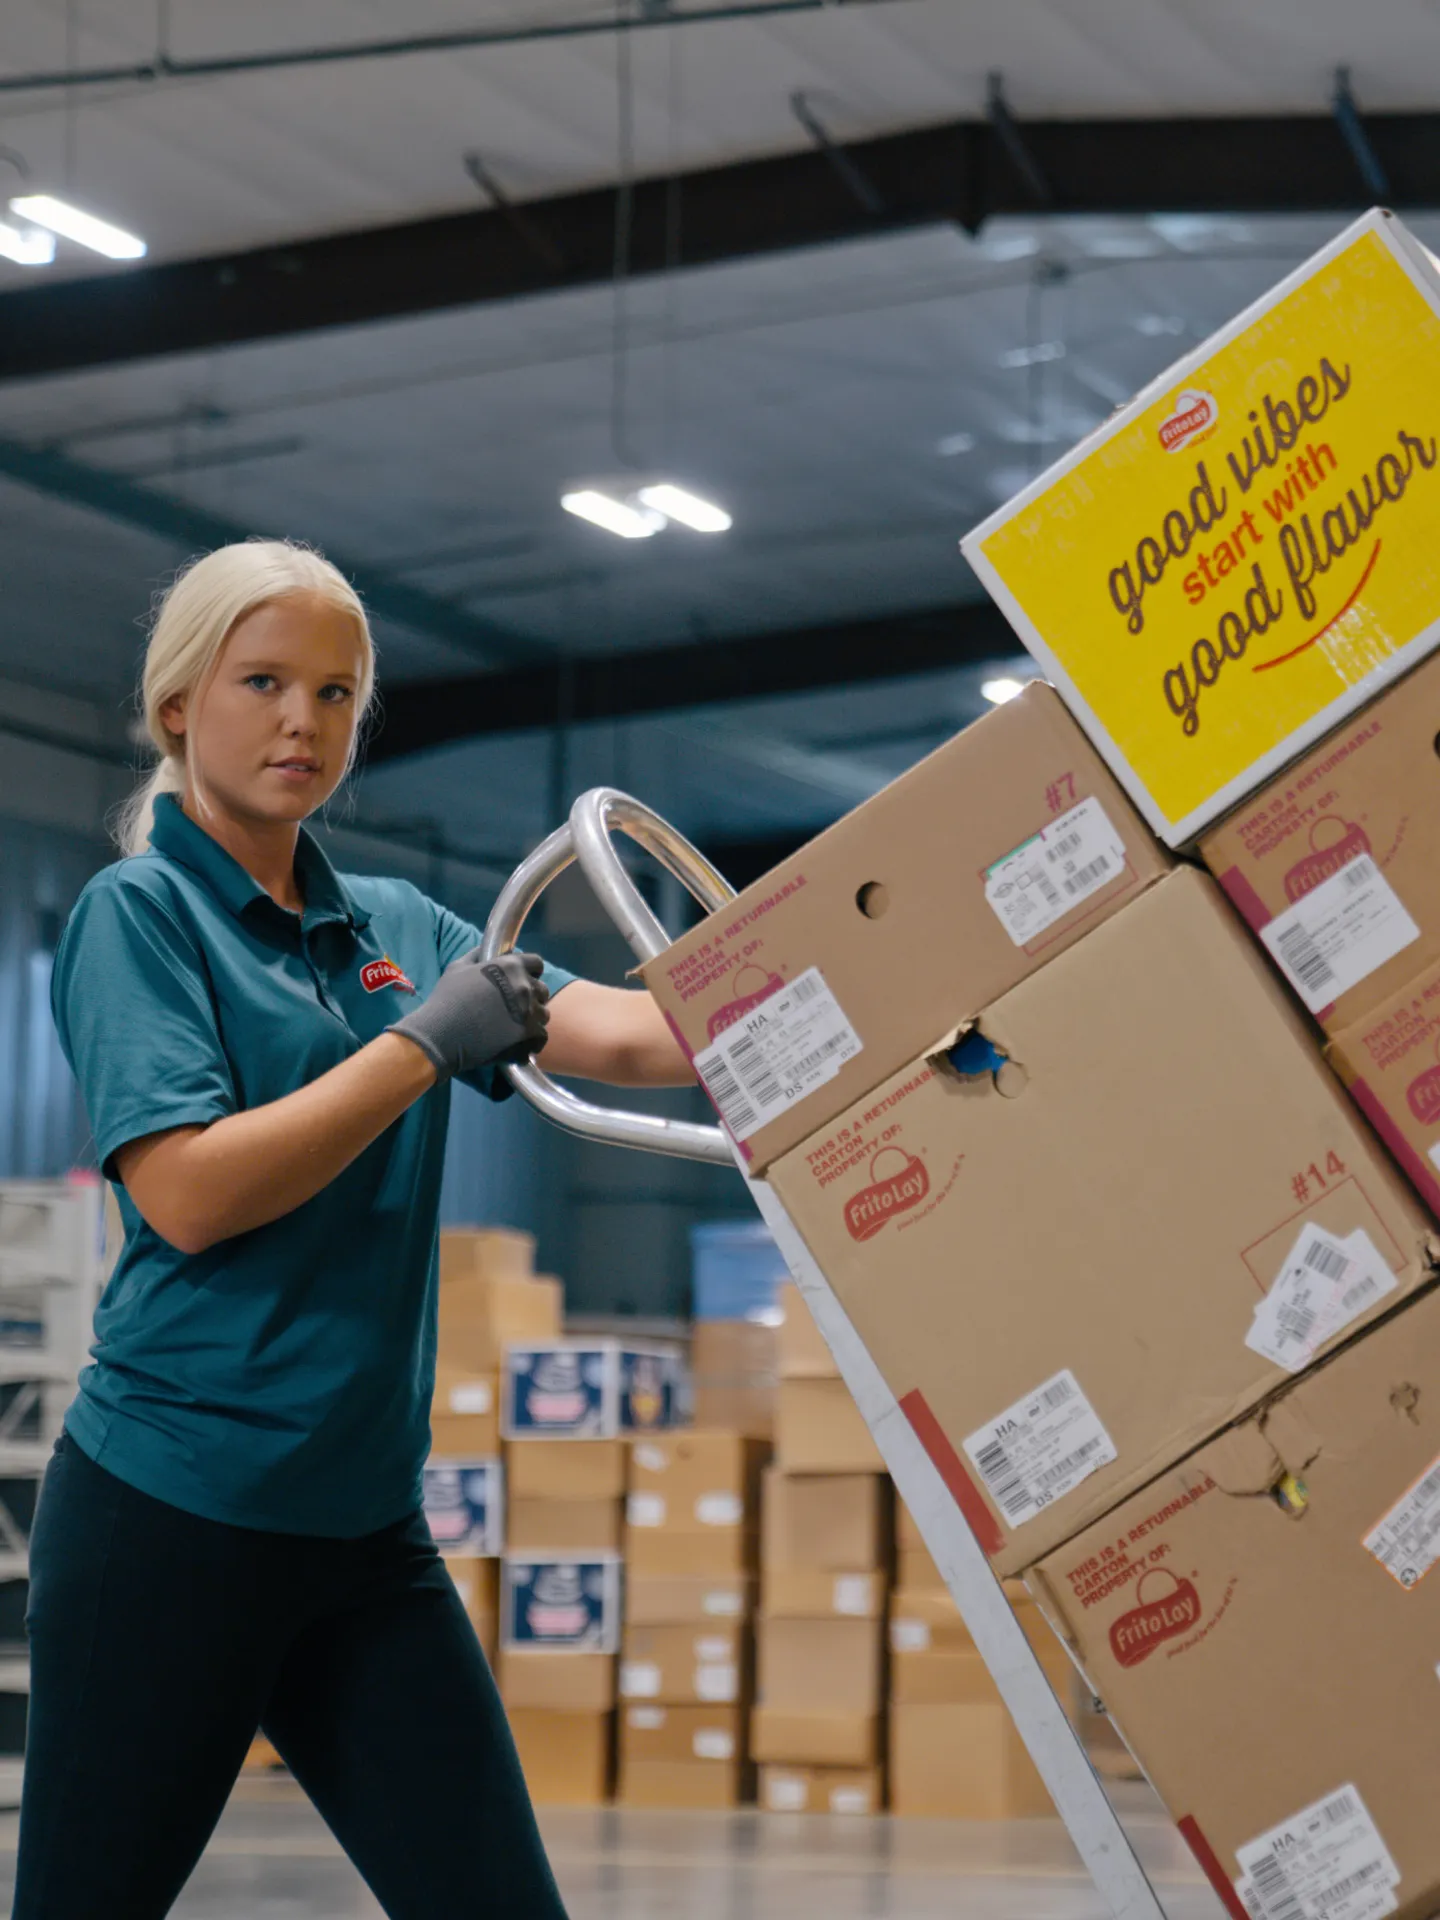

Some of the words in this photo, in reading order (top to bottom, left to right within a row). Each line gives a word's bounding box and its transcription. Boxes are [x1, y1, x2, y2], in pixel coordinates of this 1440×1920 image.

[1109, 461, 1227, 635] good
[1227, 357, 1350, 494] vibes
[1182, 510, 1264, 605] start
[1263, 443, 1338, 523] with
[1163, 562, 1283, 737] good
[1279, 430, 1436, 621] flavor
[1045, 771, 1076, 813] #7
[1236, 811, 1268, 838] THIS
[1296, 720, 1382, 792] RETURNABLE
[1245, 803, 1299, 850] CARTON
[1253, 804, 1316, 860] PROPERTY
[667, 954, 698, 980] THIS
[698, 943, 712, 959] IS
[714, 935, 724, 947] A
[724, 873, 808, 939] RETURNABLE
[673, 950, 725, 992] CARTON
[680, 952, 741, 1002] PROPERTY
[746, 1013, 768, 1034] HA
[1370, 1014, 1426, 1061] CARTON
[784, 1083, 804, 1100] DS
[805, 1139, 836, 1167] THIS
[836, 1128, 852, 1143] IS
[852, 1121, 863, 1133] A
[812, 1135, 864, 1177] CARTON
[818, 1137, 879, 1190] PROPERTY
[881, 1123, 903, 1143] OF:
[1291, 1149, 1346, 1203] #14
[994, 1419, 1018, 1439] HA
[1066, 1557, 1099, 1586] THIS
[1099, 1545, 1116, 1563] IS
[1117, 1538, 1128, 1552] A
[1127, 1475, 1217, 1544] RETURNABLE
[1073, 1553, 1130, 1598] CARTON
[1081, 1556, 1147, 1610] PROPERTY
[1272, 1833, 1296, 1852] HA
